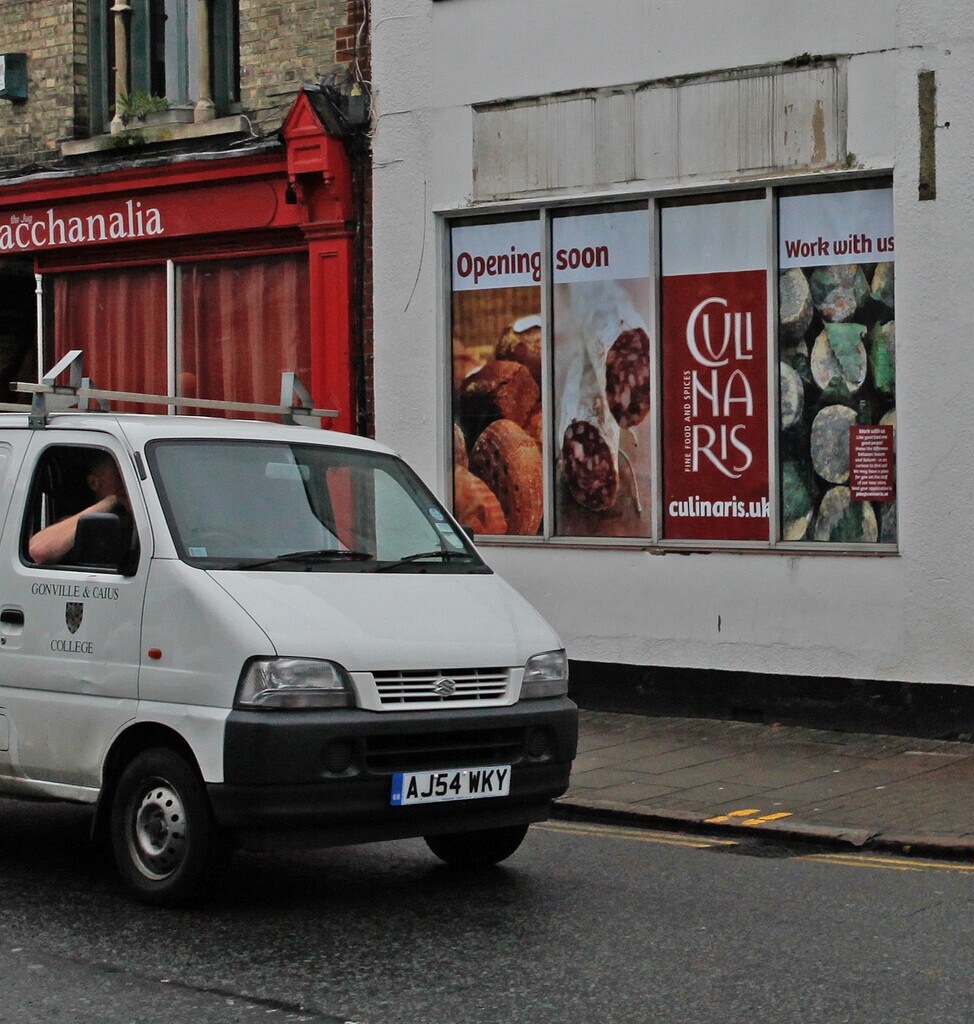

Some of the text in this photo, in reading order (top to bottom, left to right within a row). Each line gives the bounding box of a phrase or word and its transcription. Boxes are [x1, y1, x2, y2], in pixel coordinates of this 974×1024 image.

[0, 199, 165, 251] acchanalia
[784, 234, 895, 258] Work with us
[456, 245, 610, 285] Opening soon
[683, 370, 691, 400] SPICES
[683, 403, 691, 422] AND
[669, 495, 770, 518] culinaris.uk
[31, 582, 80, 598] GONVILLE
[82, 586, 90, 598] &
[50, 639, 94, 654] COLLEGE
[406, 768, 508, 800] AJ54 WKY
